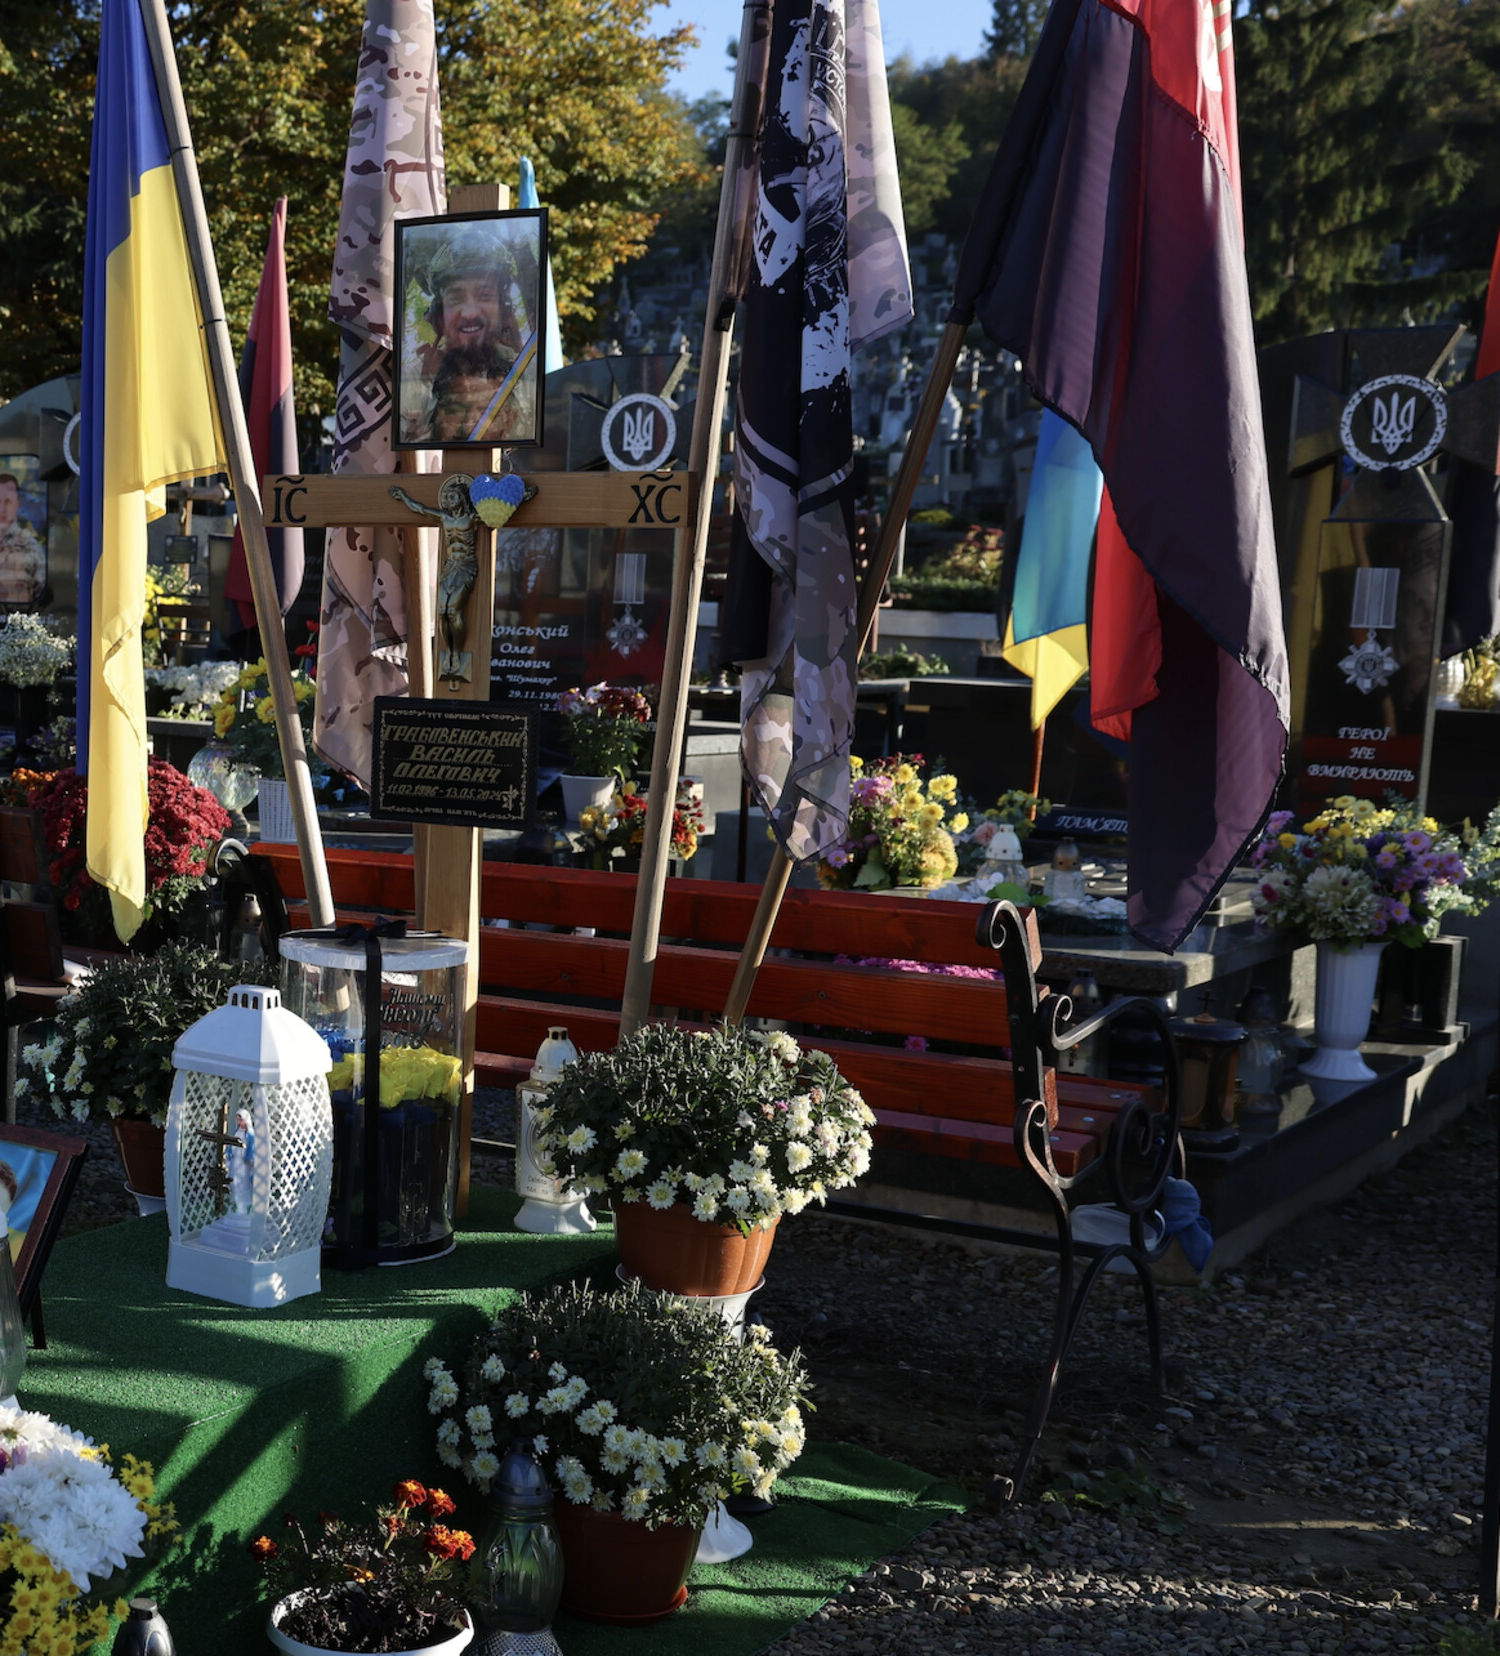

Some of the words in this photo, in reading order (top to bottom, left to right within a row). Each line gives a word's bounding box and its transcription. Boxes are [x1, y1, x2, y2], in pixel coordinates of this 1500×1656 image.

[500, 643, 536, 655] Олег
[490, 657, 551, 670] ванович
[409, 744, 496, 764] ВАСИЛЬ
[1349, 746, 1376, 760] НЕ
[393, 762, 501, 783] ОЛЕГОВИЧ
[1307, 764, 1415, 782] ВМИРАЮТЬ
[1055, 815, 1128, 834] ПАМ'ЯТ
